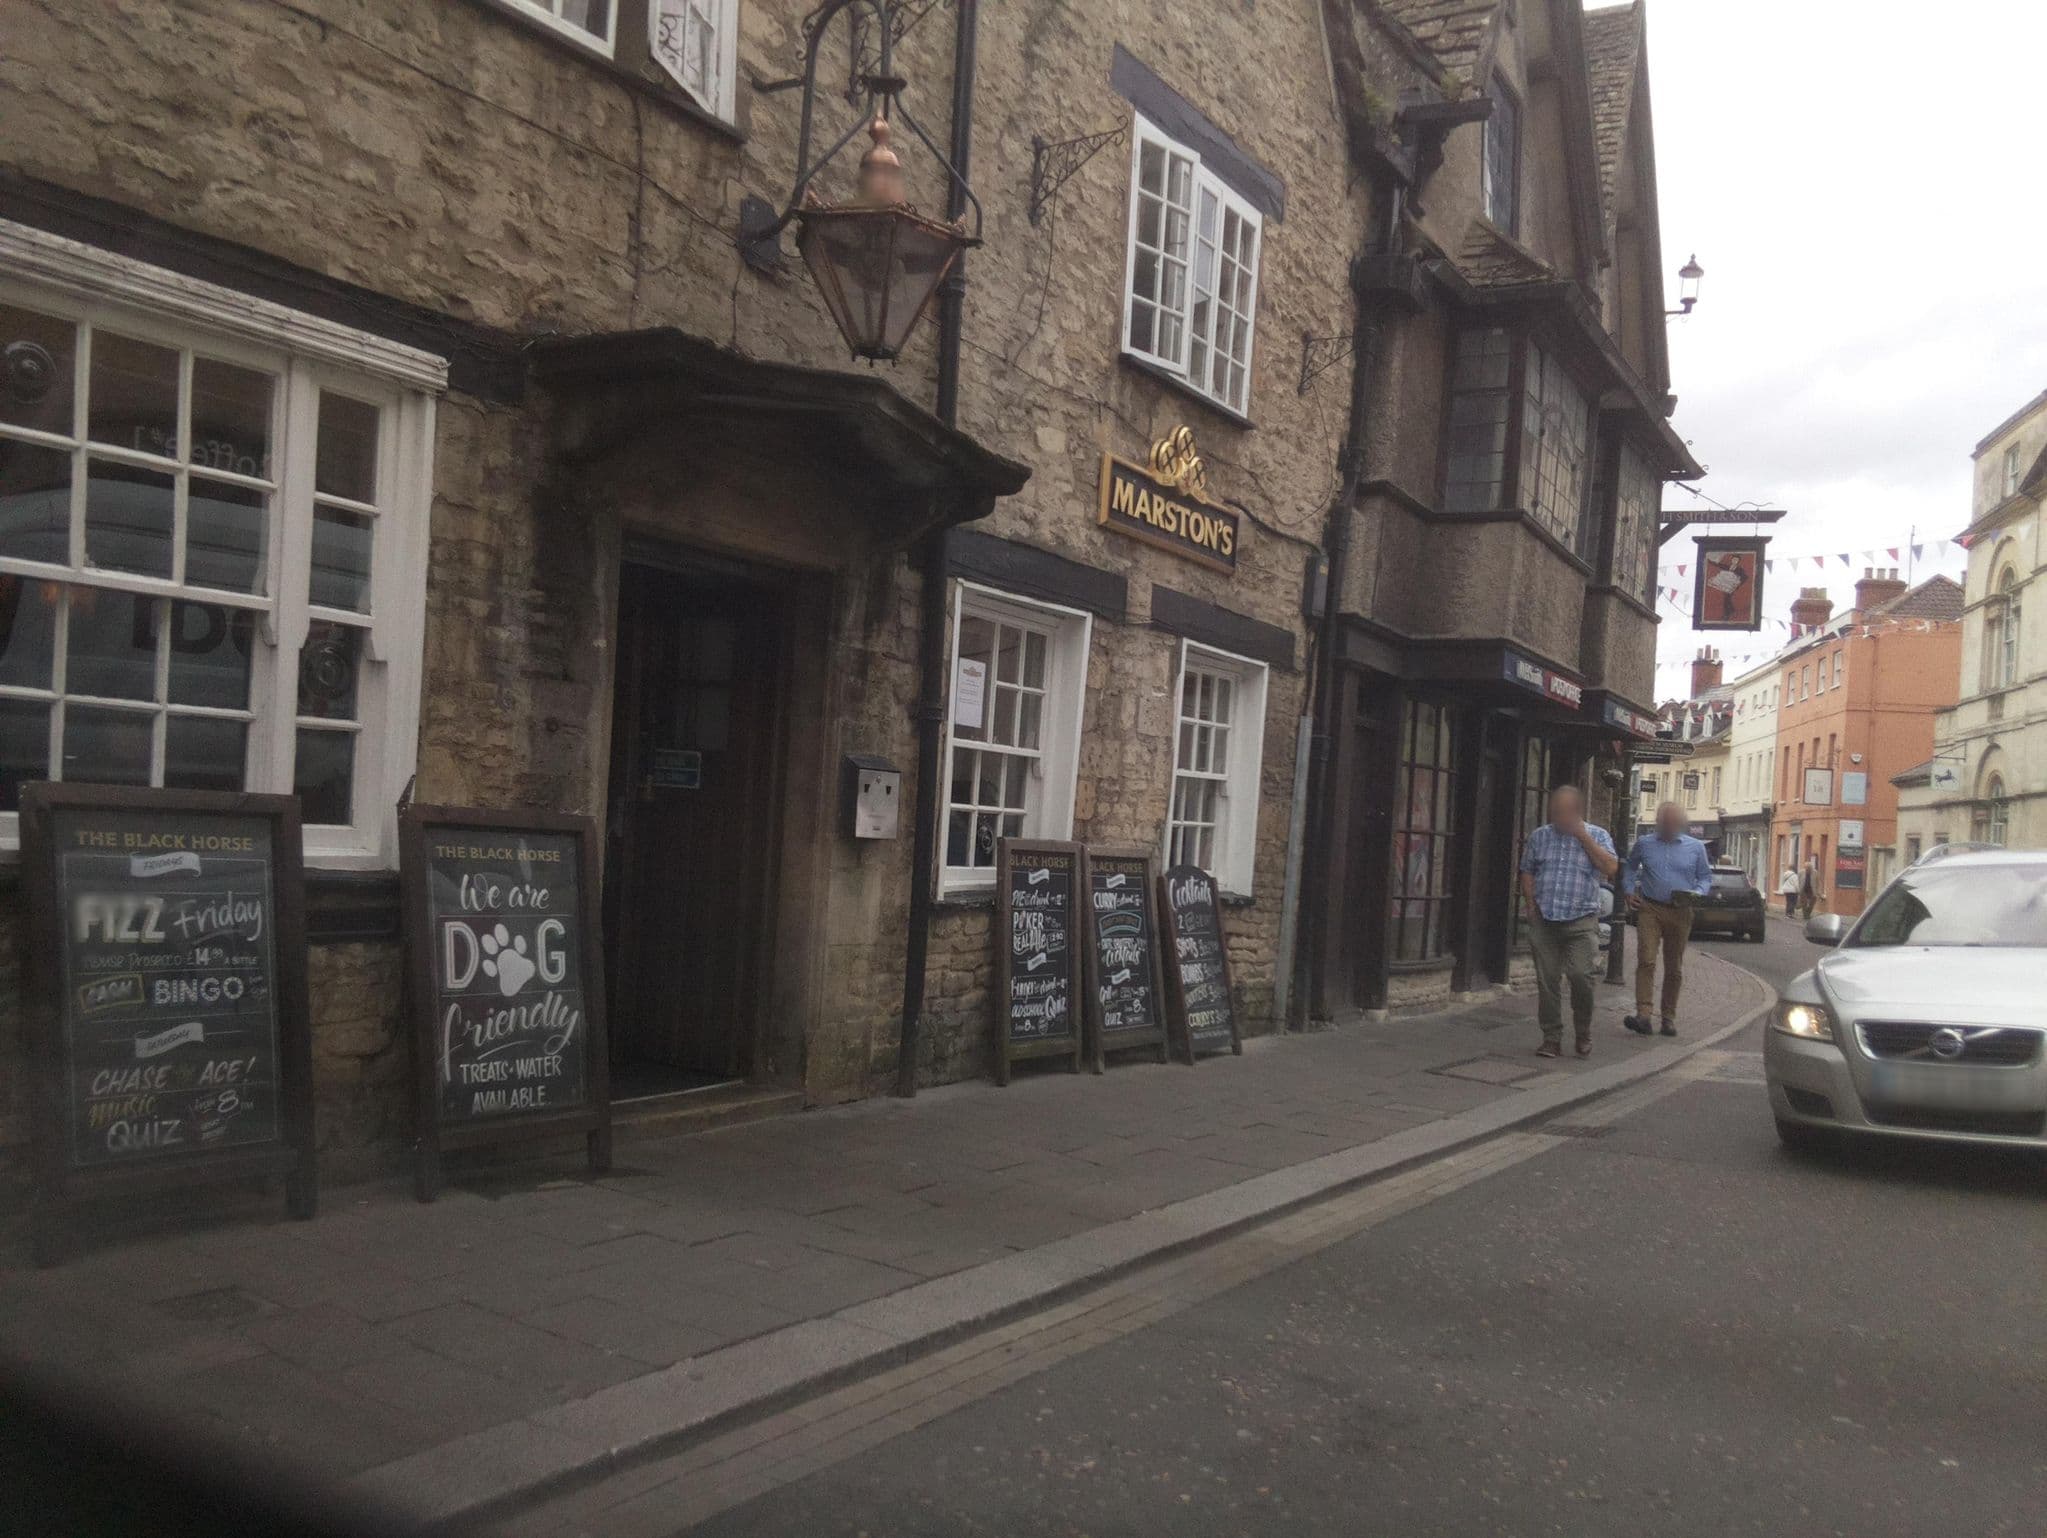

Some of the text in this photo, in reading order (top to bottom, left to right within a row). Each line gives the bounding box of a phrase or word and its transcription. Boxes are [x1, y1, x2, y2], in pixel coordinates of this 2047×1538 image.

[1111, 475, 1234, 556] MARSTON'S
[1730, 512, 1758, 522] SON
[78, 831, 254, 852] THE BLACK HORSE
[436, 846, 561, 863] THE BLACK HORSE
[460, 872, 551, 912] We are
[174, 890, 262, 942] Friday
[154, 976, 245, 1005] BINGO
[91, 1065, 172, 1096] CHASE
